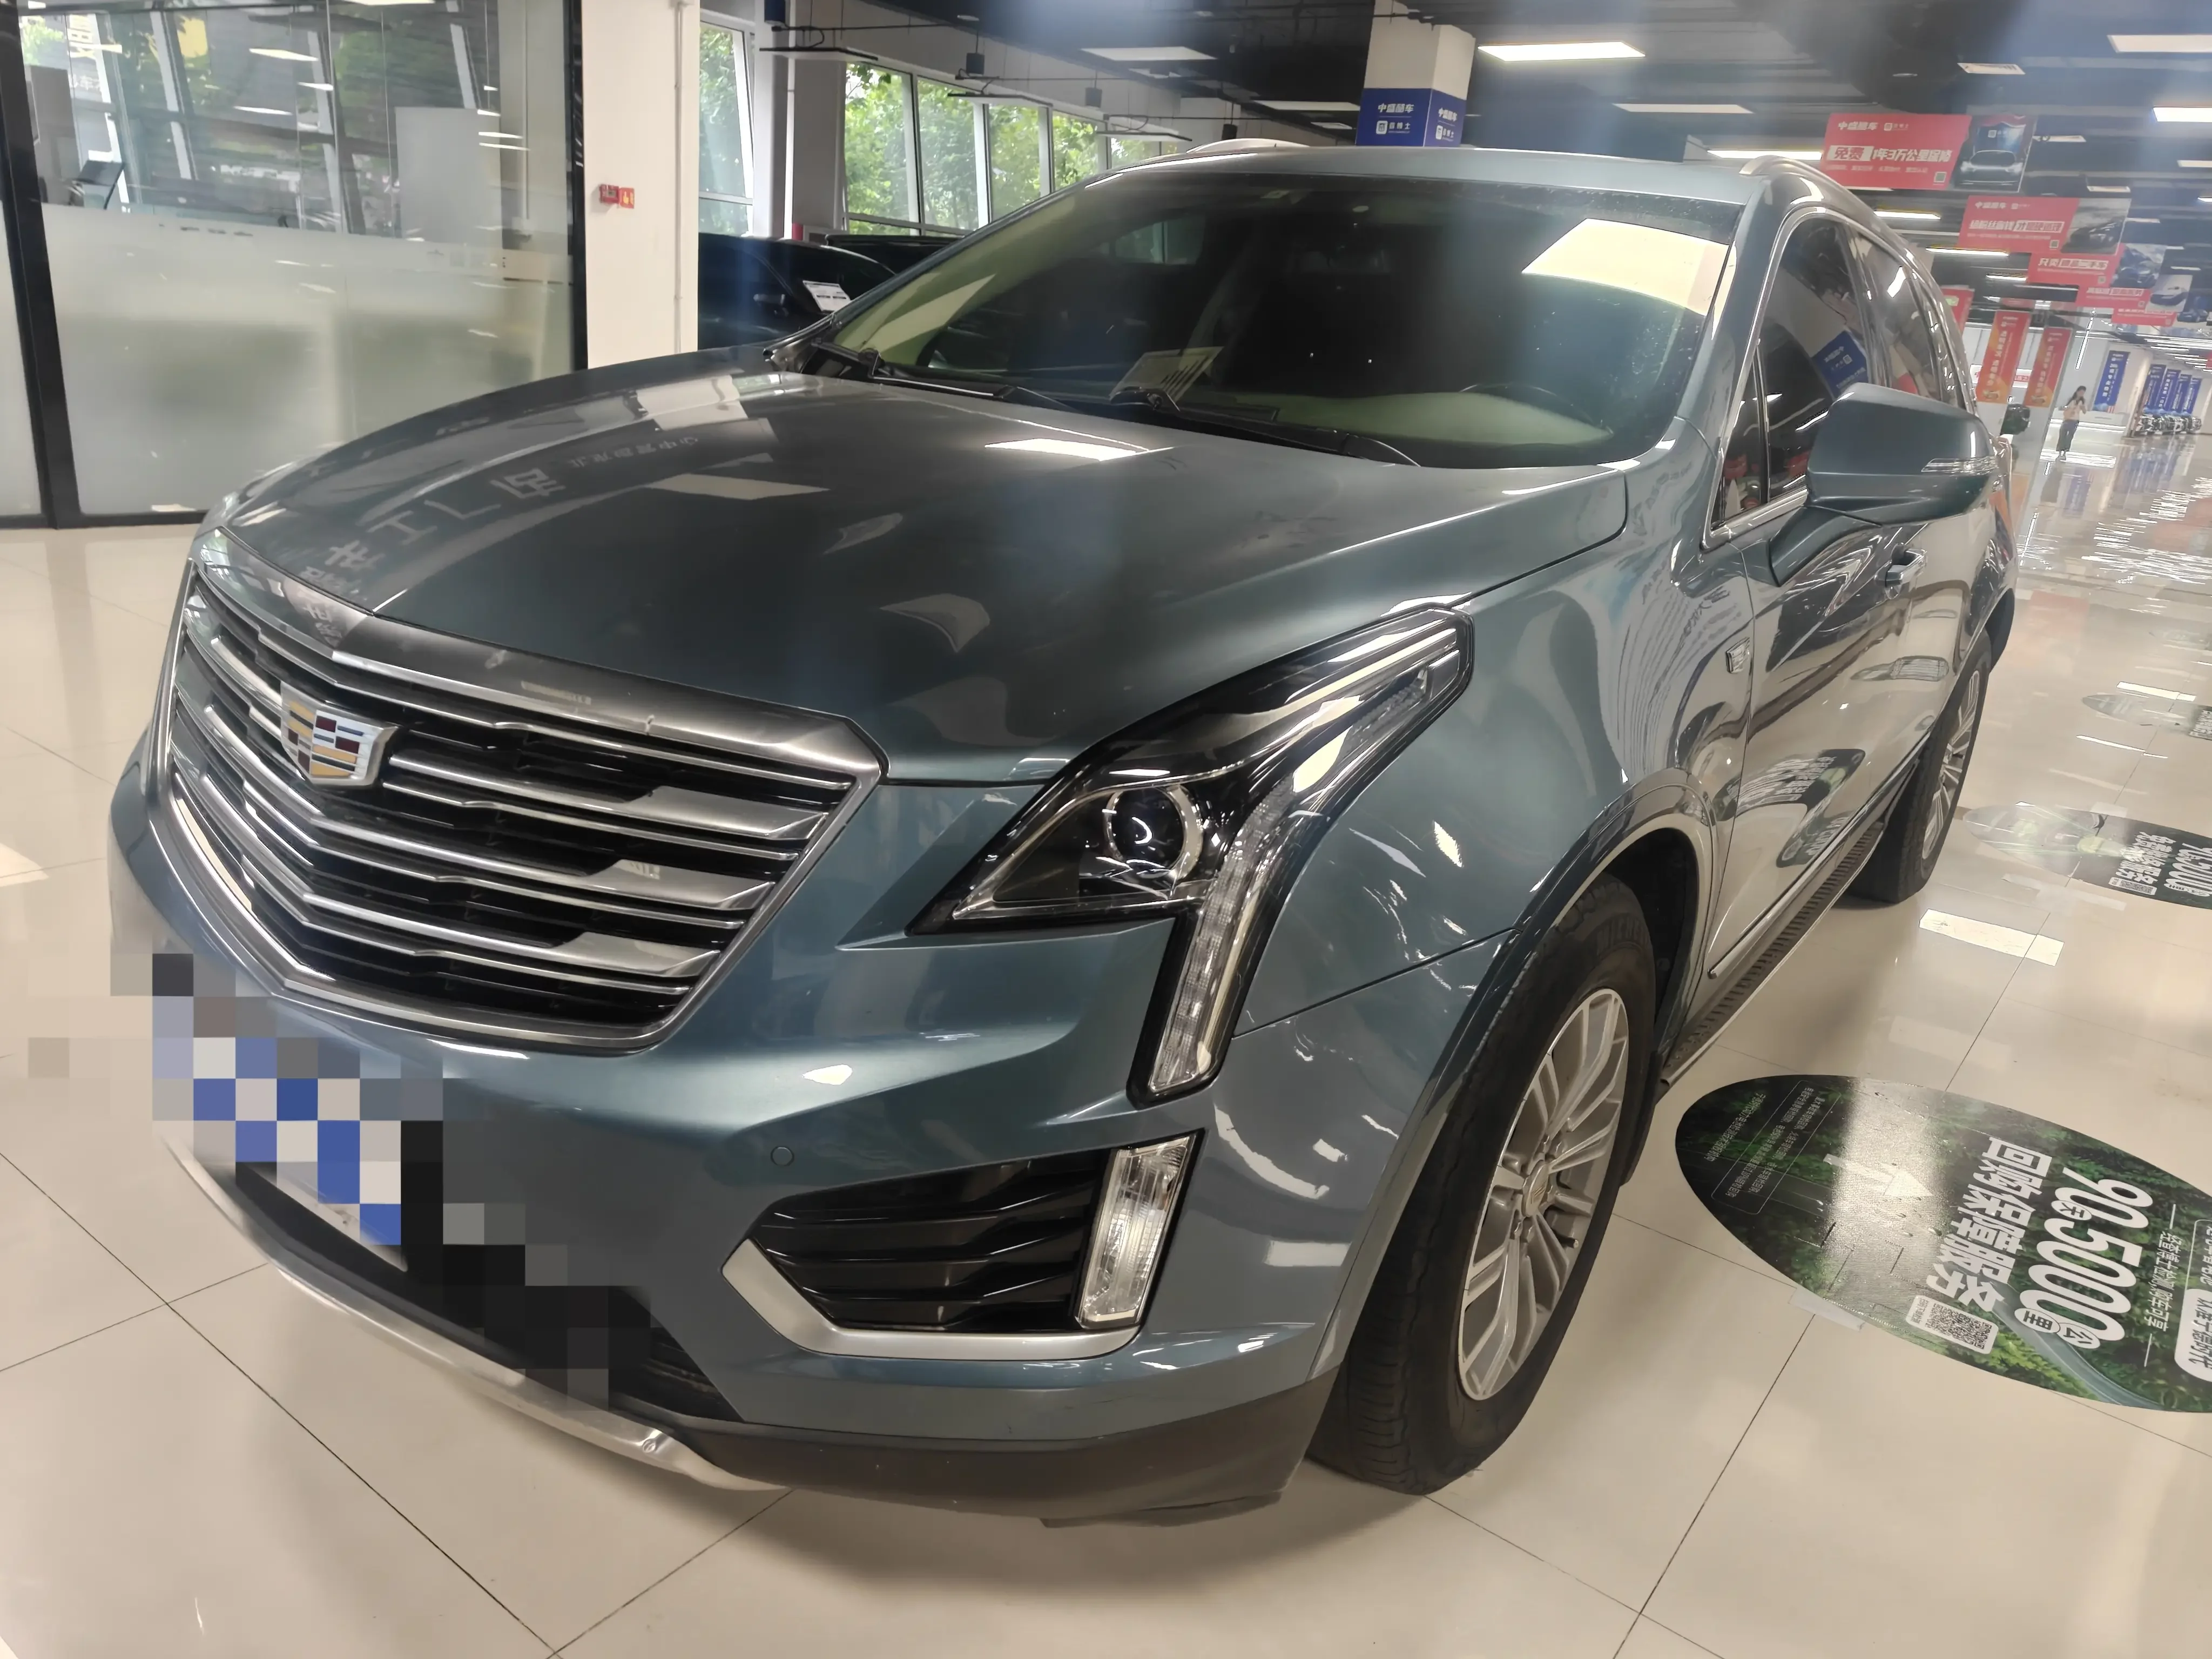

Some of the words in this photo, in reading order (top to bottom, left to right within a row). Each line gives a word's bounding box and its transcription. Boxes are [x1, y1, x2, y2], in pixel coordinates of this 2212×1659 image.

[1924, 1137, 2053, 1313] 回购保障服务
